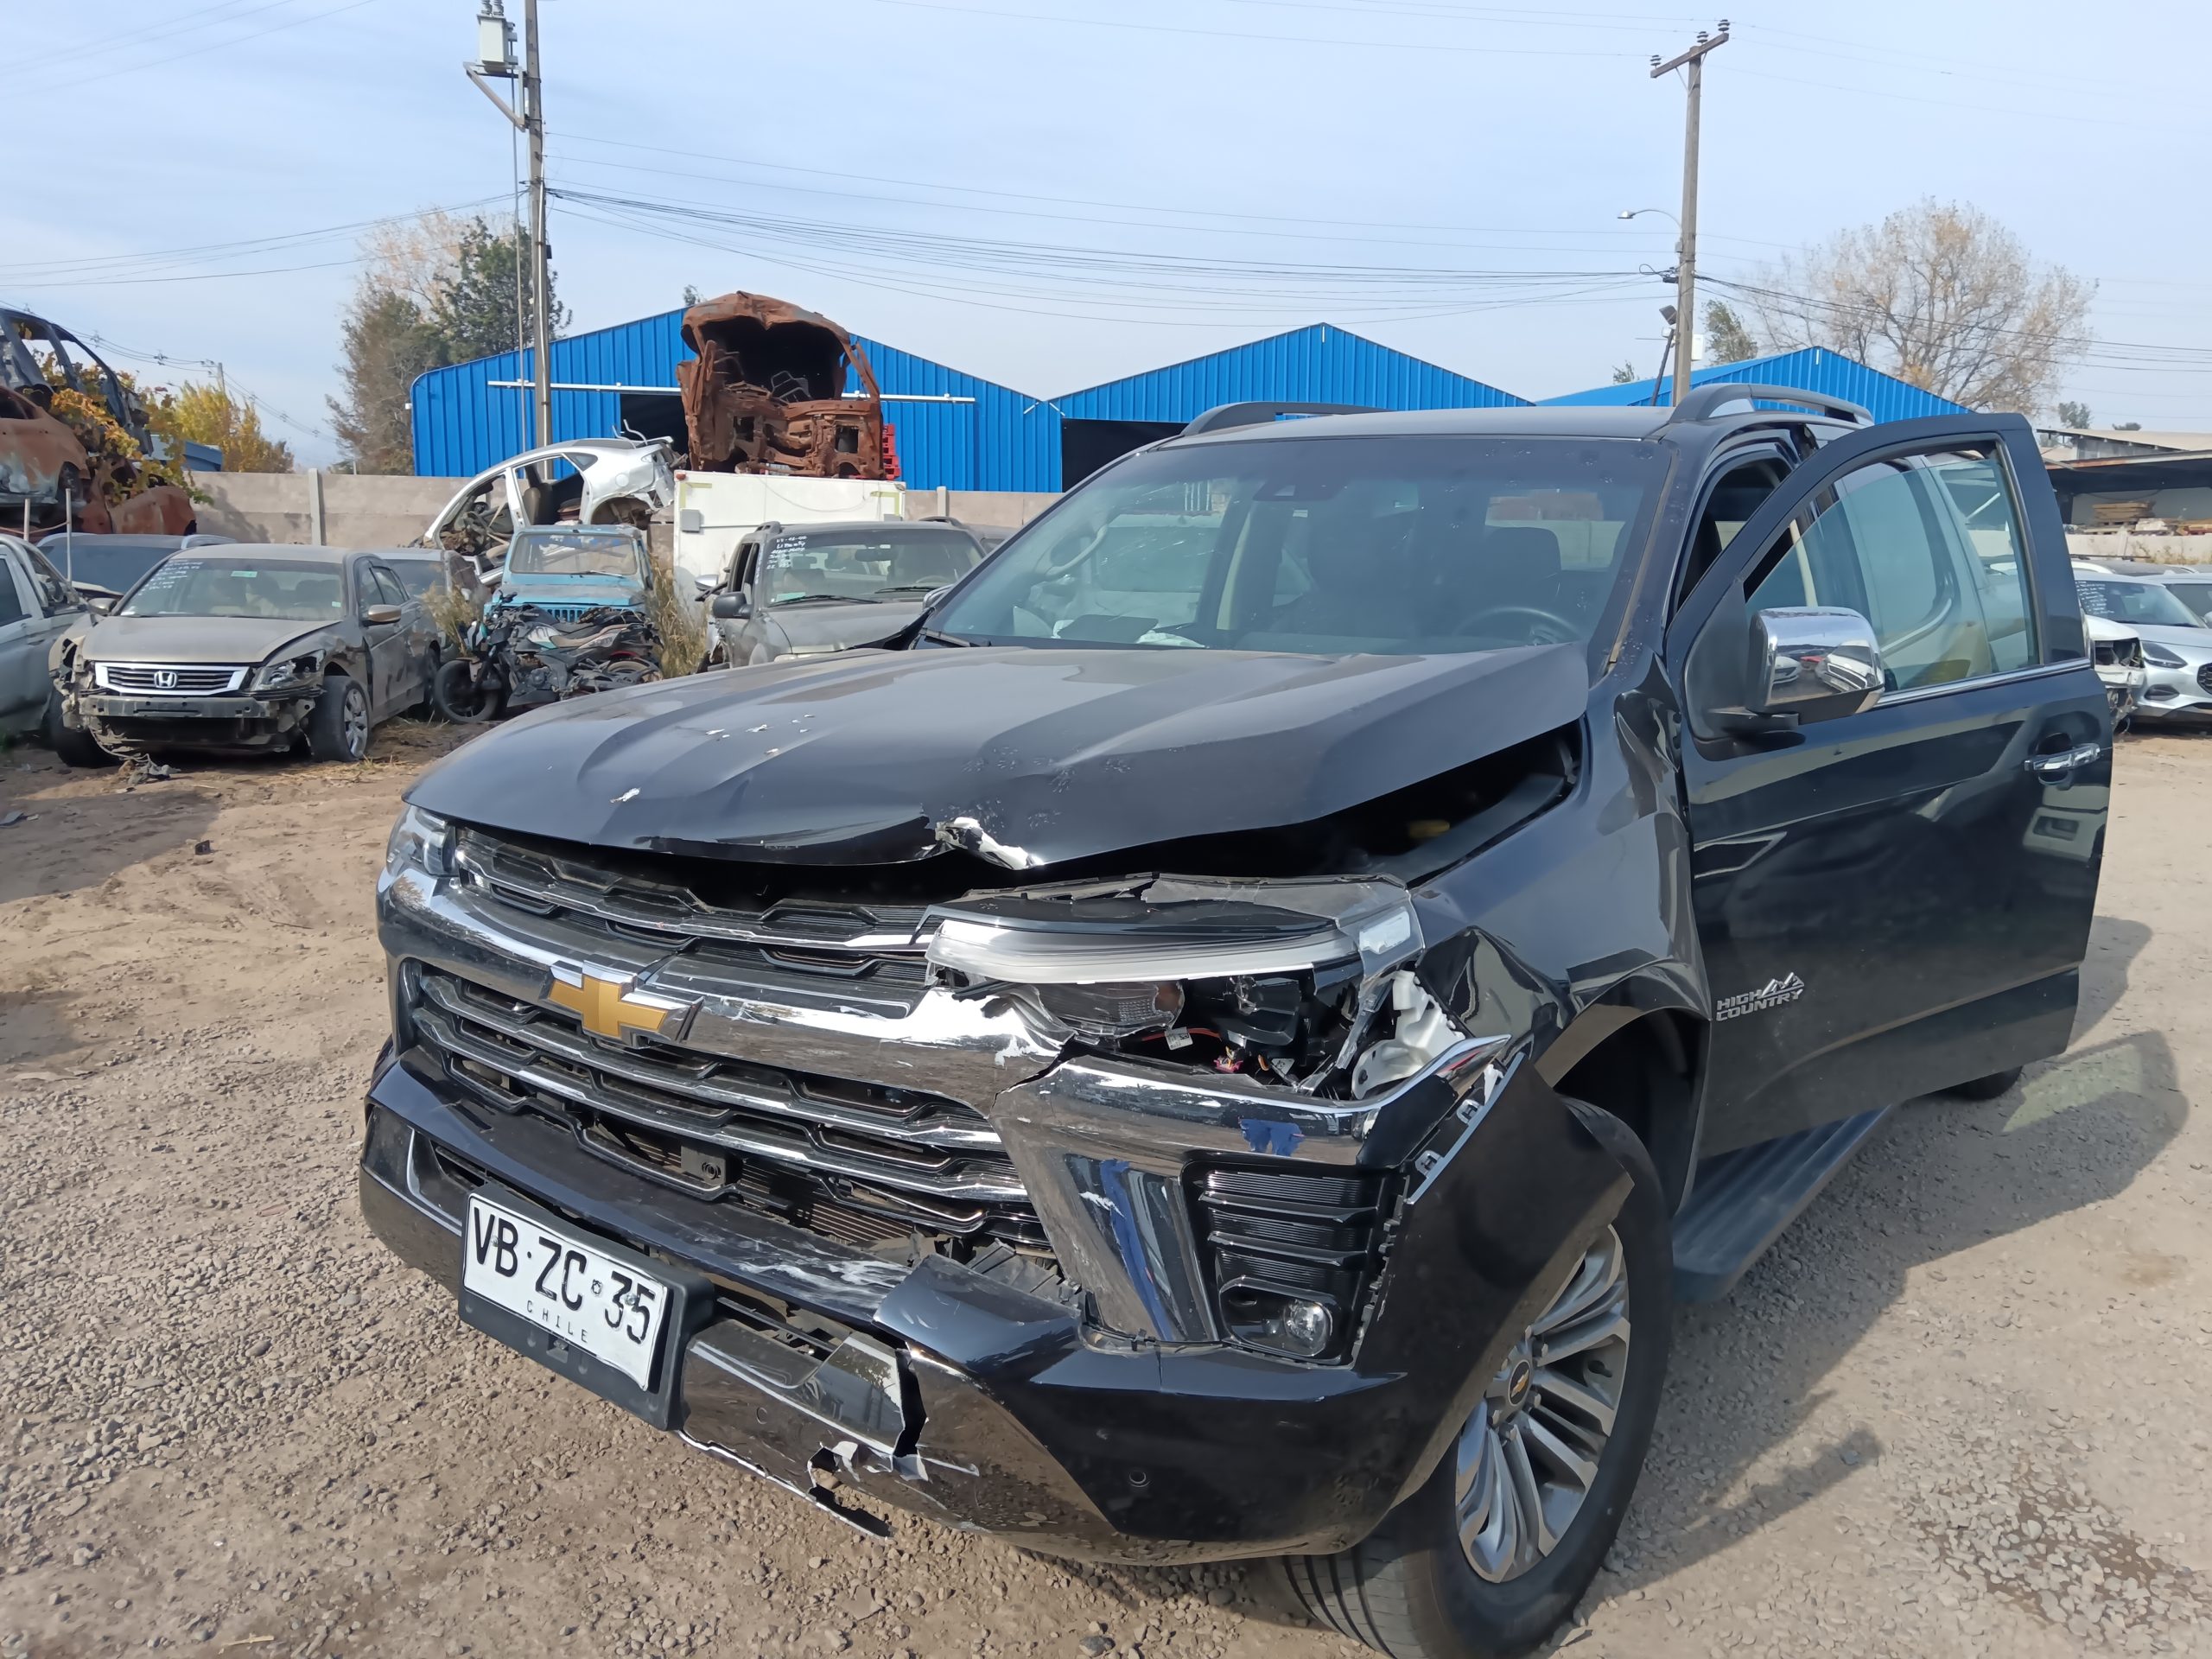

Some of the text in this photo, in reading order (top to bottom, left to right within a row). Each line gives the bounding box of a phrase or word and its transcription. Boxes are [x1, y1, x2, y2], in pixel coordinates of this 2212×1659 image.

[1715, 988, 1804, 1021] COUNTRY
[1716, 988, 1764, 1011] HIGH
[526, 1299, 588, 1344] CHILE
